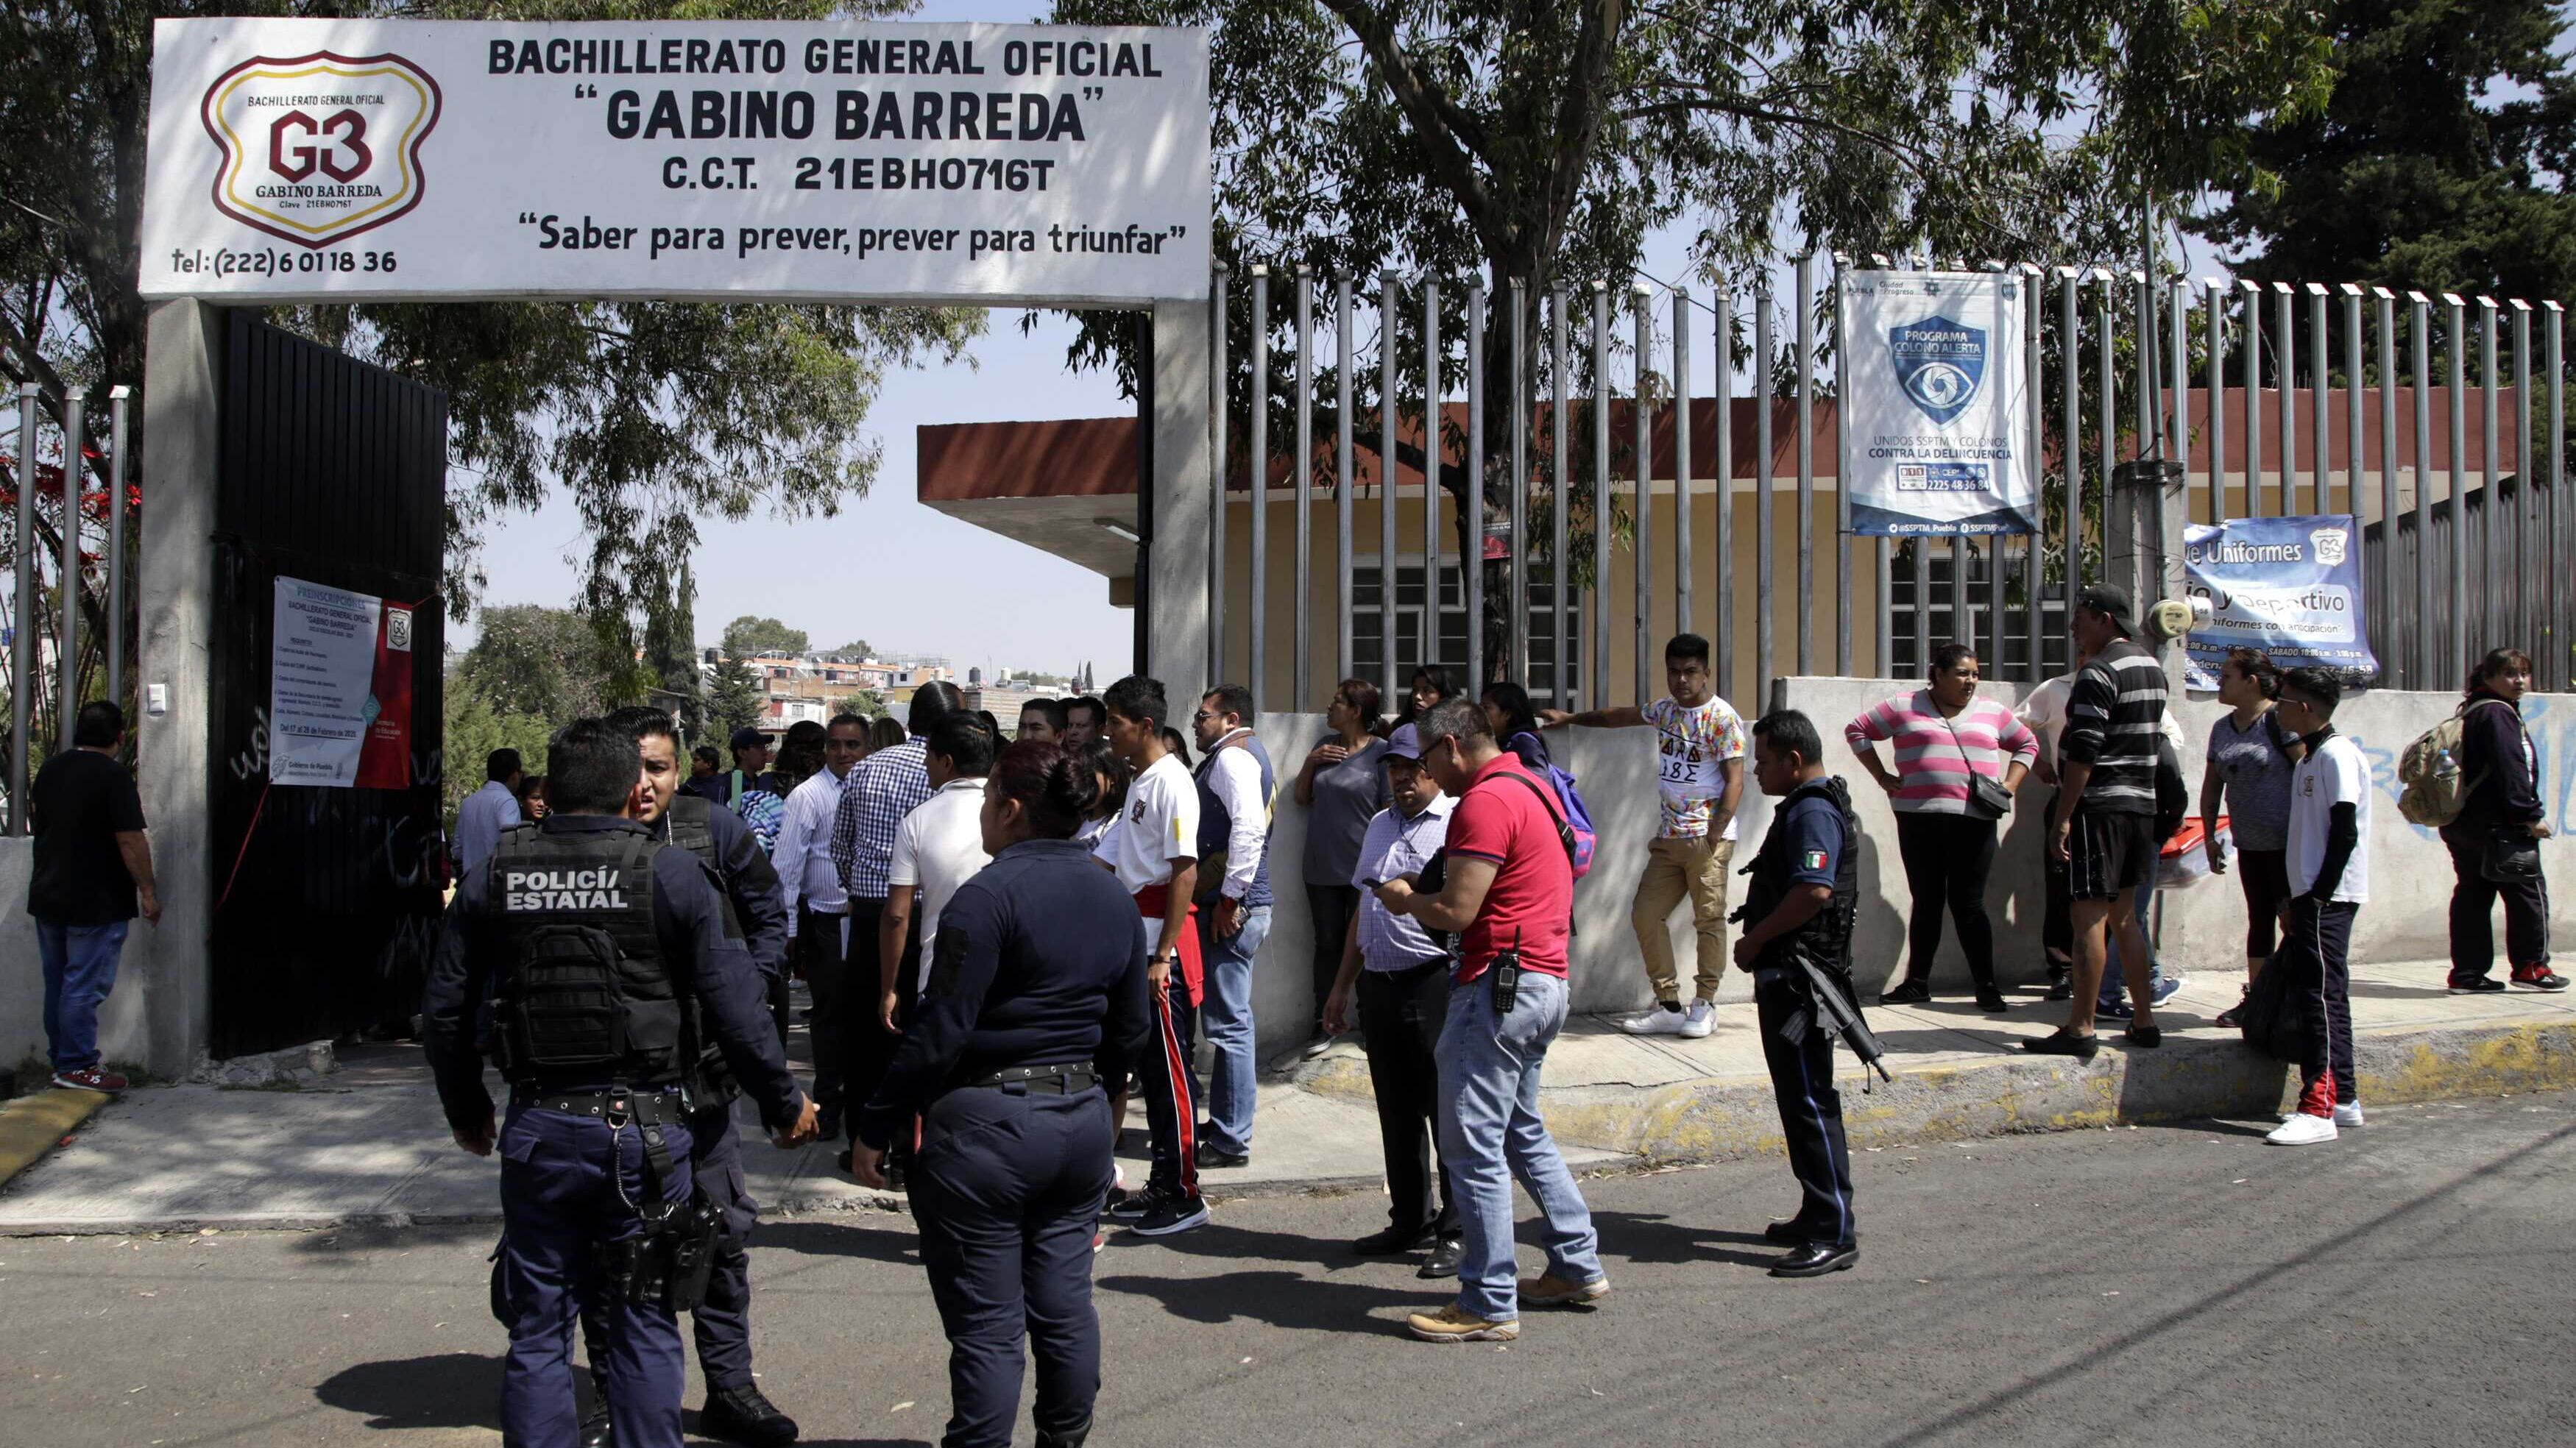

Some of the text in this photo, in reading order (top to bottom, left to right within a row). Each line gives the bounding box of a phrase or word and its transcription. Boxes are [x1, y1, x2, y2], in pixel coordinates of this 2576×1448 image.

[488, 38, 1163, 77] BACHILLERATO GENERAL OFICIAL
[247, 95, 385, 107] BACHILLERATO GENERAL OFICIAL
[662, 156, 758, 190] C.C.T.
[255, 185, 383, 198] GABINO BARREDA
[279, 200, 301, 209] Clave
[650, 227, 725, 260] para
[738, 227, 851, 259] prever,
[858, 228, 960, 260] prever
[970, 230, 1036, 261] para
[1905, 331, 1968, 342] PROGRAMA
[1894, 342, 1981, 354] COLONO ALERTA
[1874, 436, 1914, 446] UNIDOS
[1917, 436, 1949, 446] SSPTM
[1960, 437, 2007, 447] COLONOS
[1868, 448, 2012, 460] CONTRA LA DELINCUENCIA
[1928, 480, 1949, 491] 2225
[2207, 541, 2303, 564] Uniformes
[2218, 591, 2233, 610] y
[506, 890, 629, 911] ESTATAL
